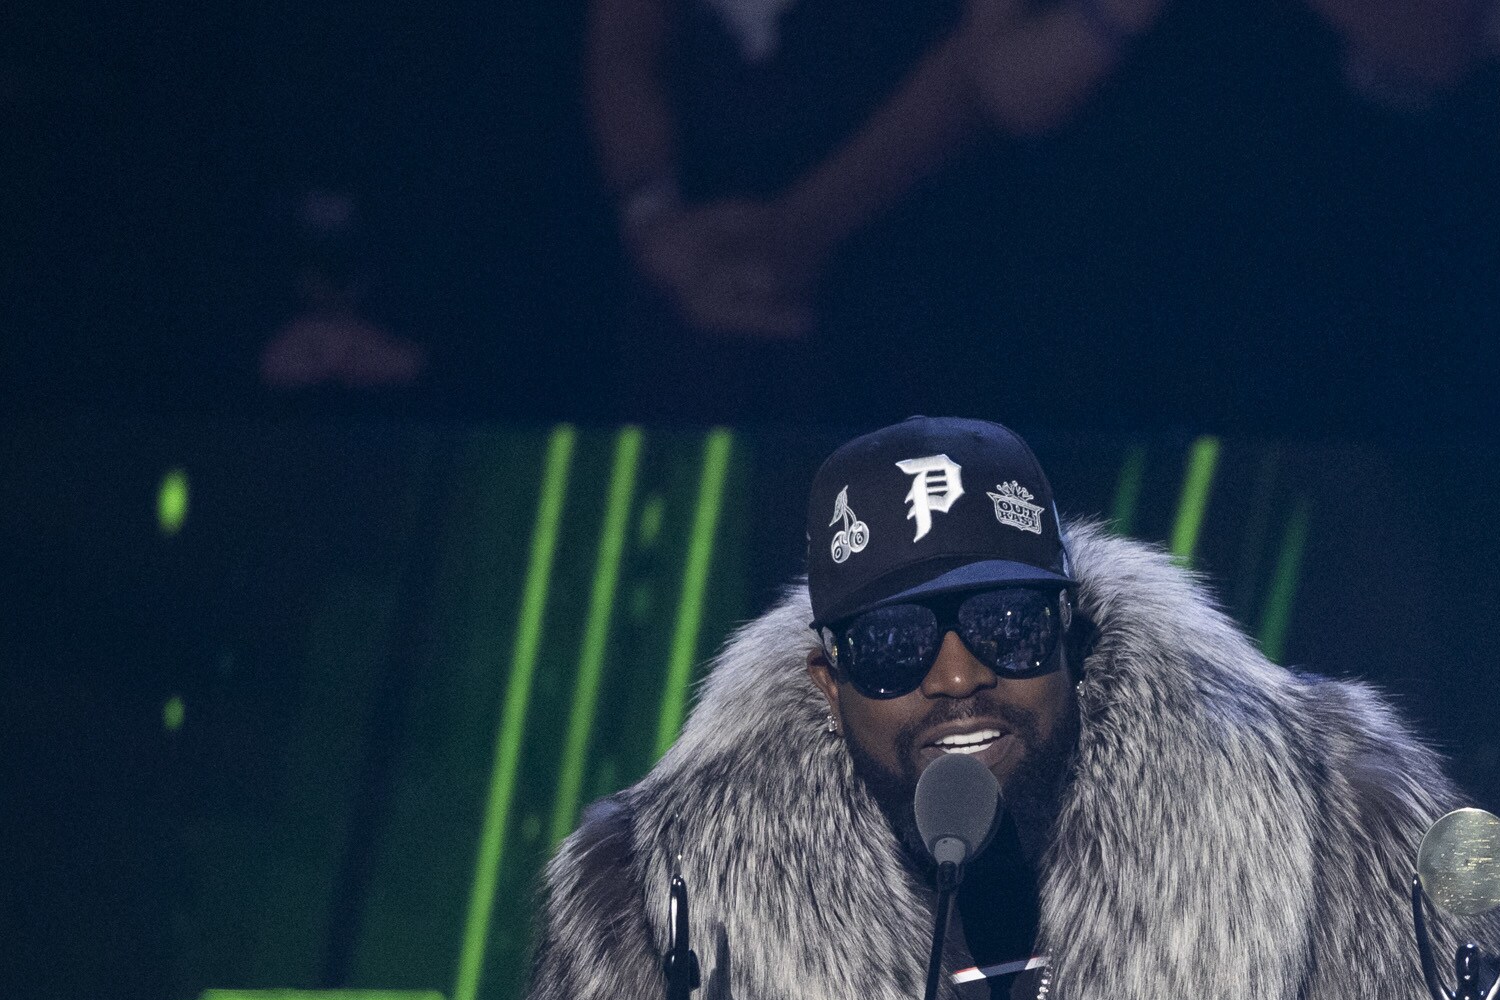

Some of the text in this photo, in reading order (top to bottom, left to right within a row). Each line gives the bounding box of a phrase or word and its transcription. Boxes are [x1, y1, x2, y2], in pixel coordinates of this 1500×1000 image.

[895, 453, 965, 543] P
[998, 500, 1037, 519] OUT
[999, 510, 1037, 527] KAST
